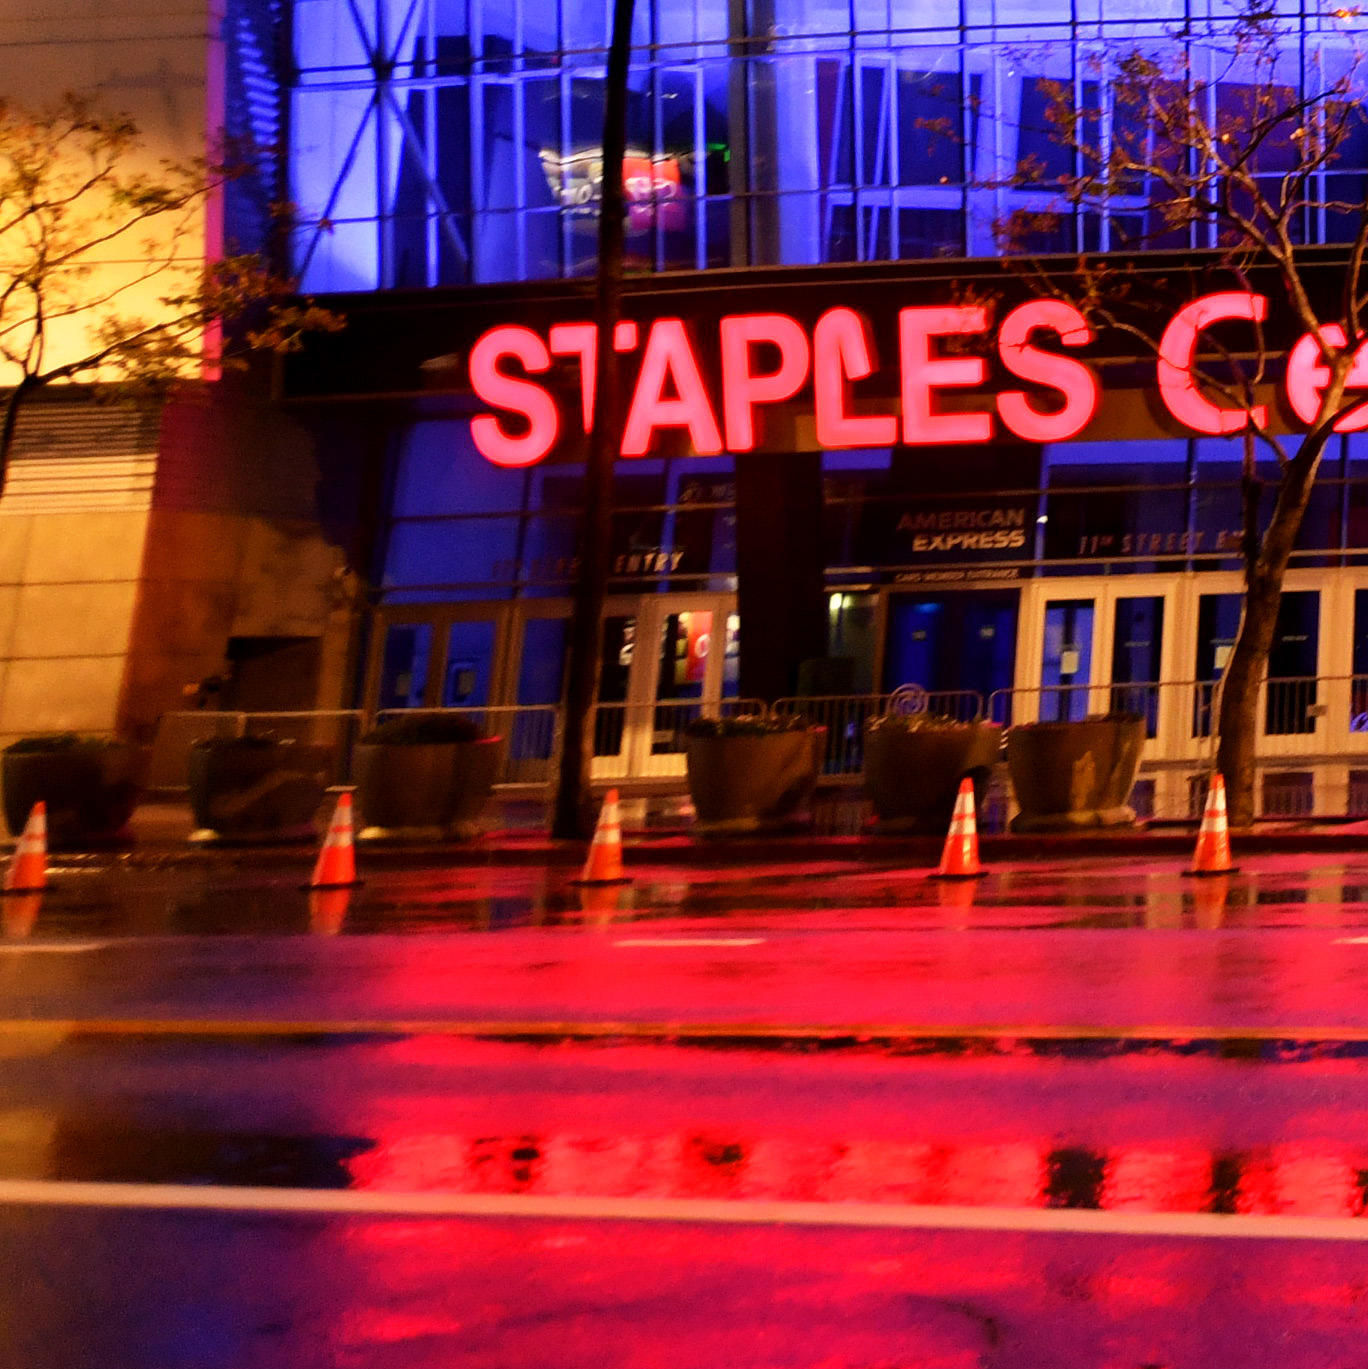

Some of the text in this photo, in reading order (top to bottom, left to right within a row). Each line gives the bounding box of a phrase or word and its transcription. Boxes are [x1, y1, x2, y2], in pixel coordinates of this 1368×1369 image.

[468, 297, 1099, 468] STAPLES
[898, 508, 1026, 530] AMERICAN
[911, 529, 1026, 552] EXPRESS
[1121, 530, 1206, 554] STREET
[613, 550, 686, 573] ENTRY
